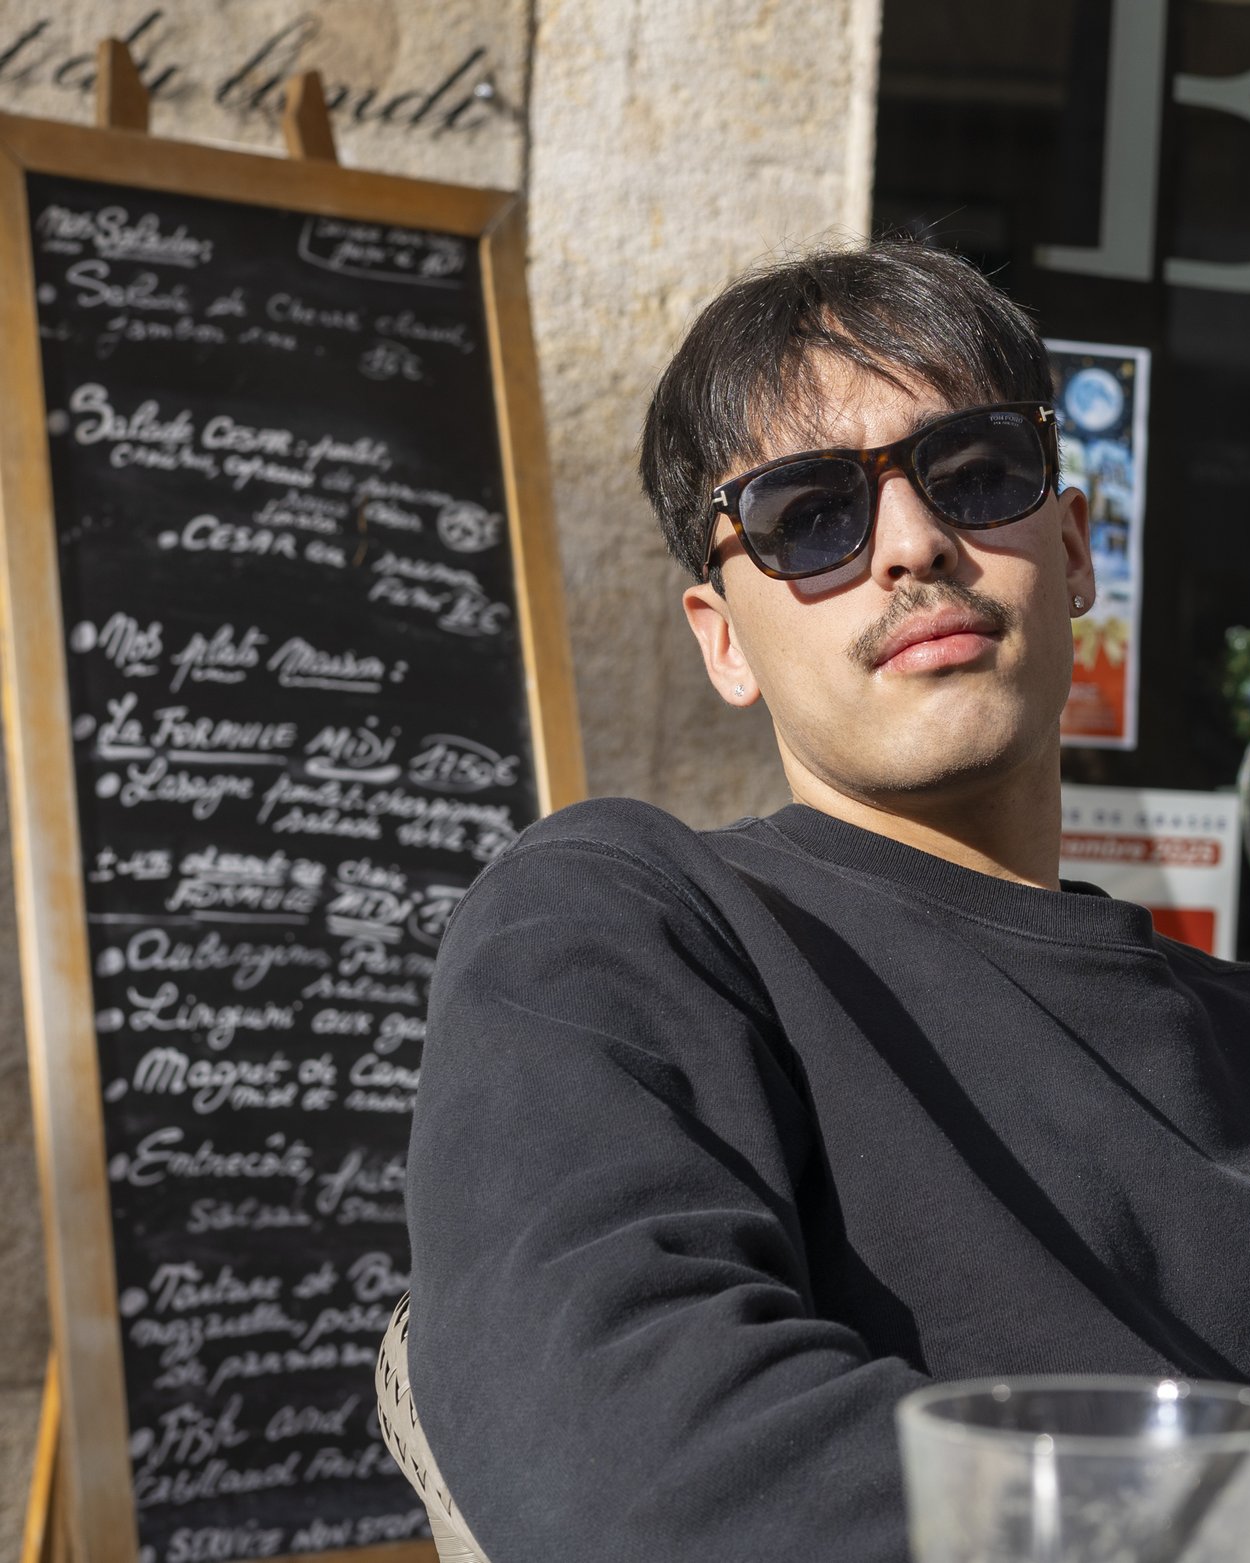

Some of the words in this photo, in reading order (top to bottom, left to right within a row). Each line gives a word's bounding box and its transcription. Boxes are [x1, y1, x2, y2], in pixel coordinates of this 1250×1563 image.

[65, 258, 191, 313] Salade
[69, 382, 195, 446] Salade
[181, 514, 297, 560] CESAR
[169, 622, 270, 694] plats
[311, 1007, 374, 1036] aux
[132, 1047, 292, 1115] Magret
[298, 1052, 338, 1086] de
